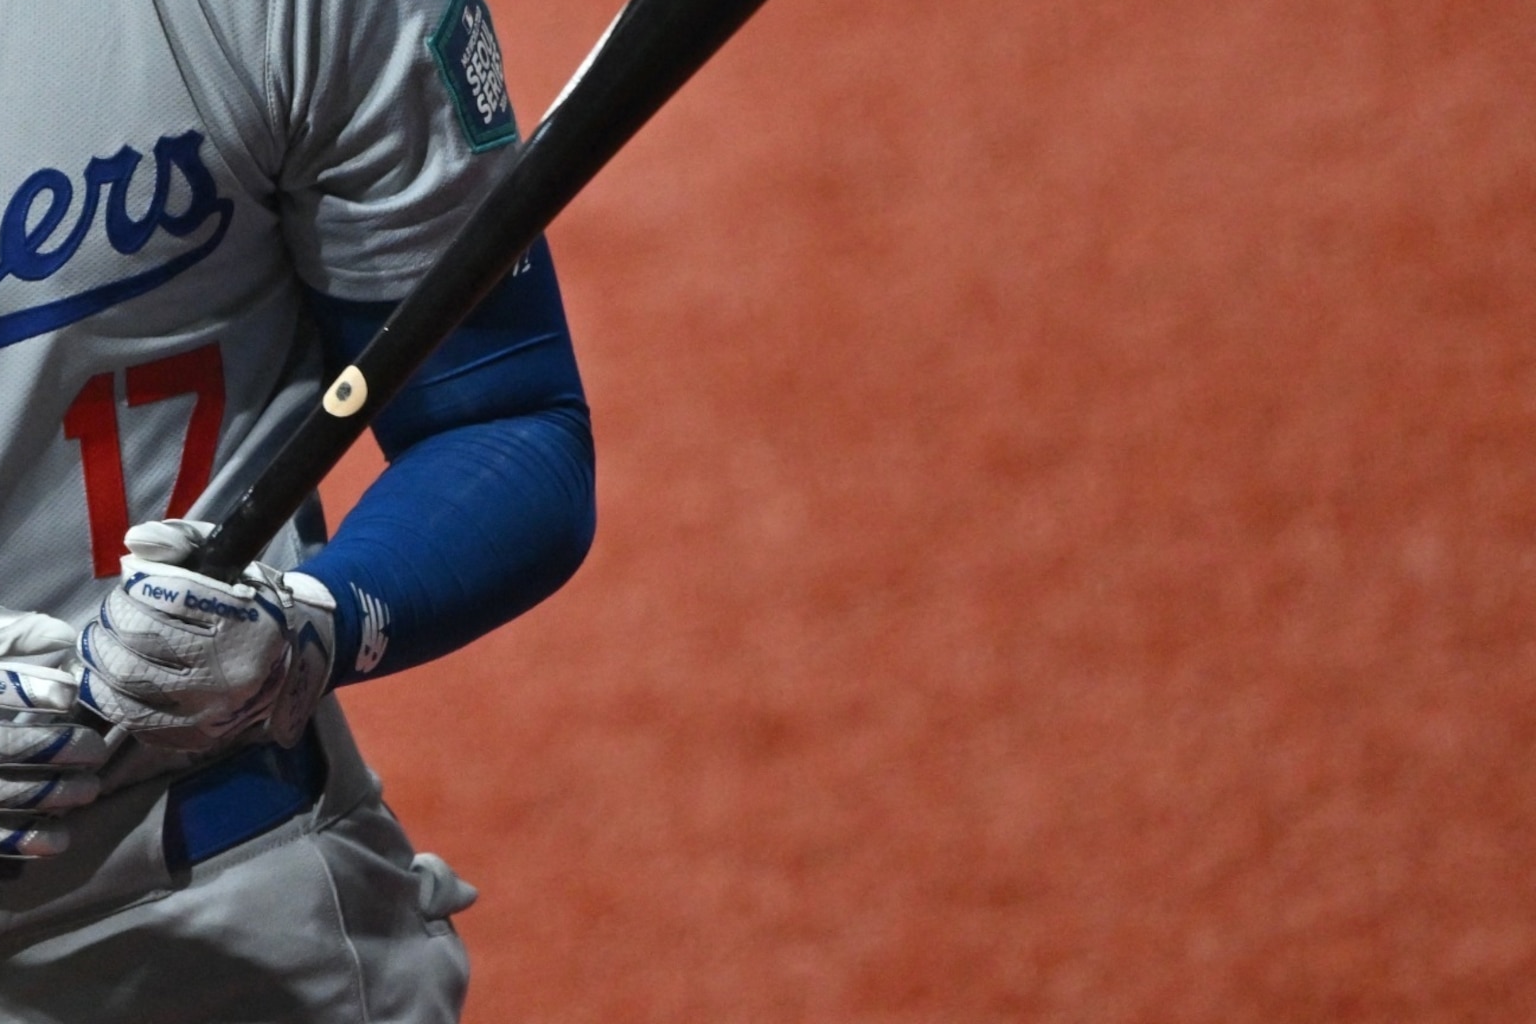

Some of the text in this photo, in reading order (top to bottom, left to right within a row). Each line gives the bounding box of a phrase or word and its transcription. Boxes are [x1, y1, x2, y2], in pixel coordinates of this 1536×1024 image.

[62, 341, 226, 579] 17
[142, 583, 260, 623] new balance
